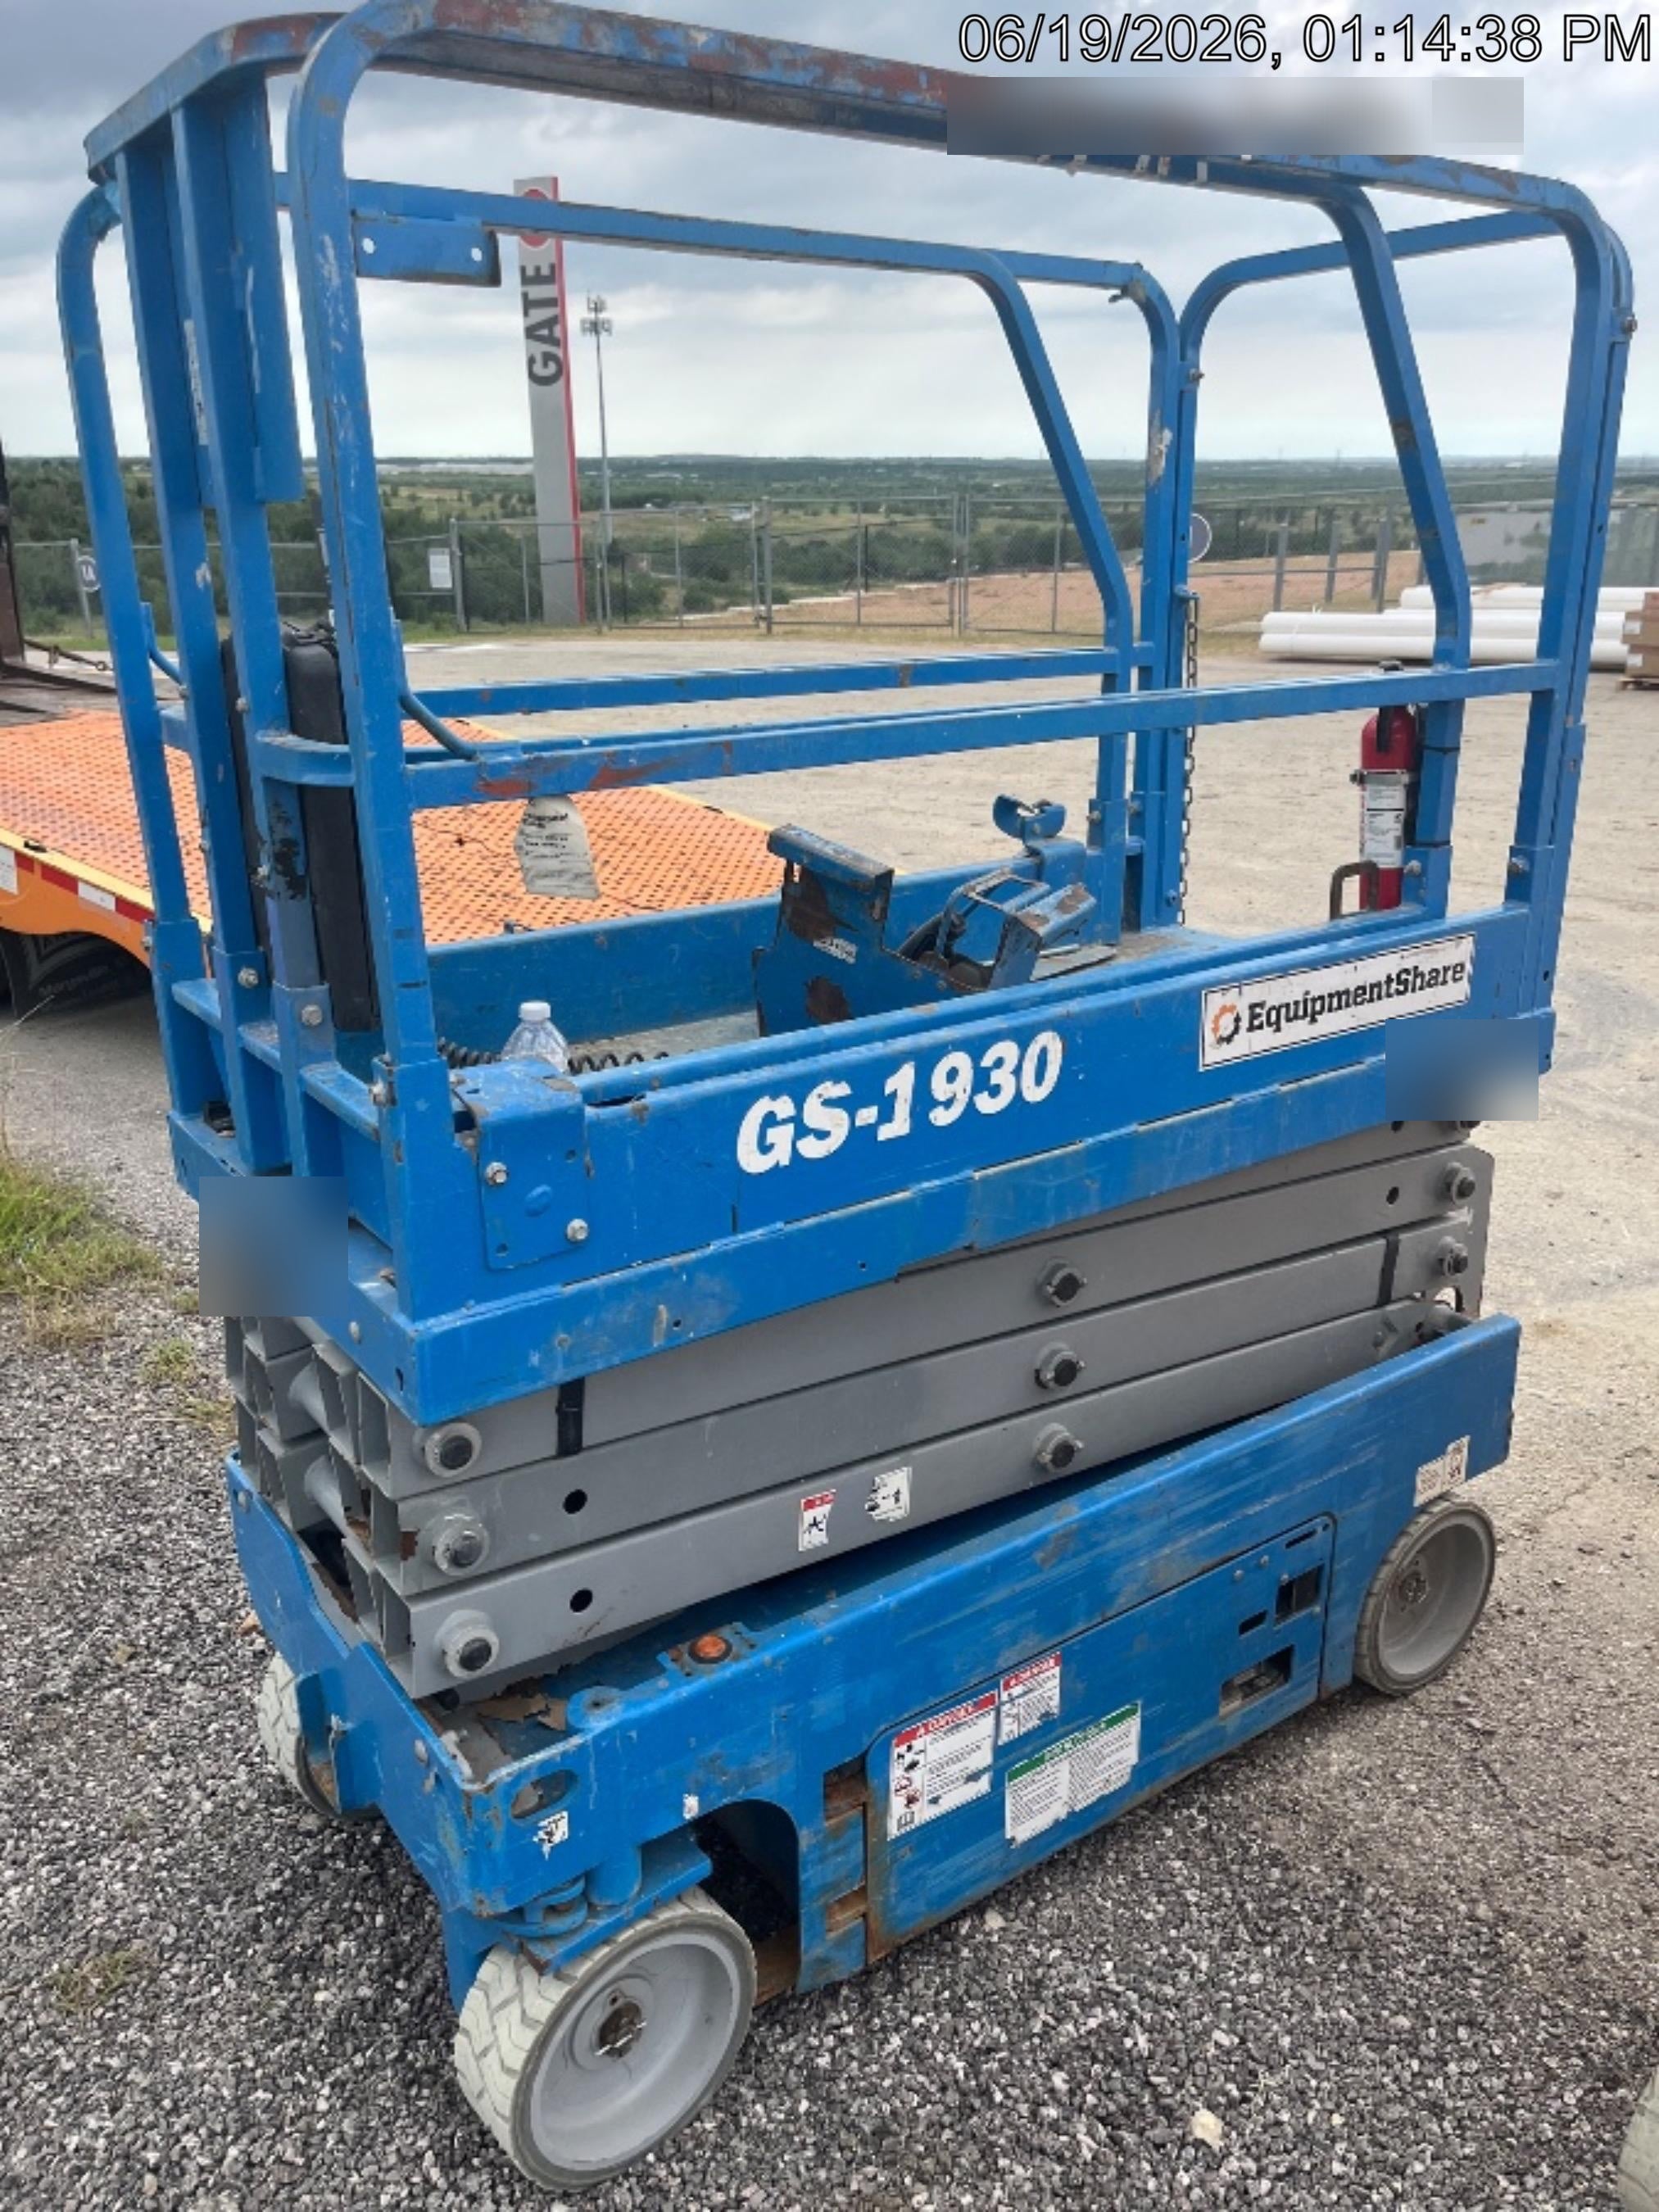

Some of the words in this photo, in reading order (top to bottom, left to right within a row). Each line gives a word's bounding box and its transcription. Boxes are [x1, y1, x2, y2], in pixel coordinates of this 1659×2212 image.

[520, 263, 564, 387] GATE
[1246, 962, 1466, 1033] EquipmentShare
[737, 1031, 1063, 1175] GS-1930
